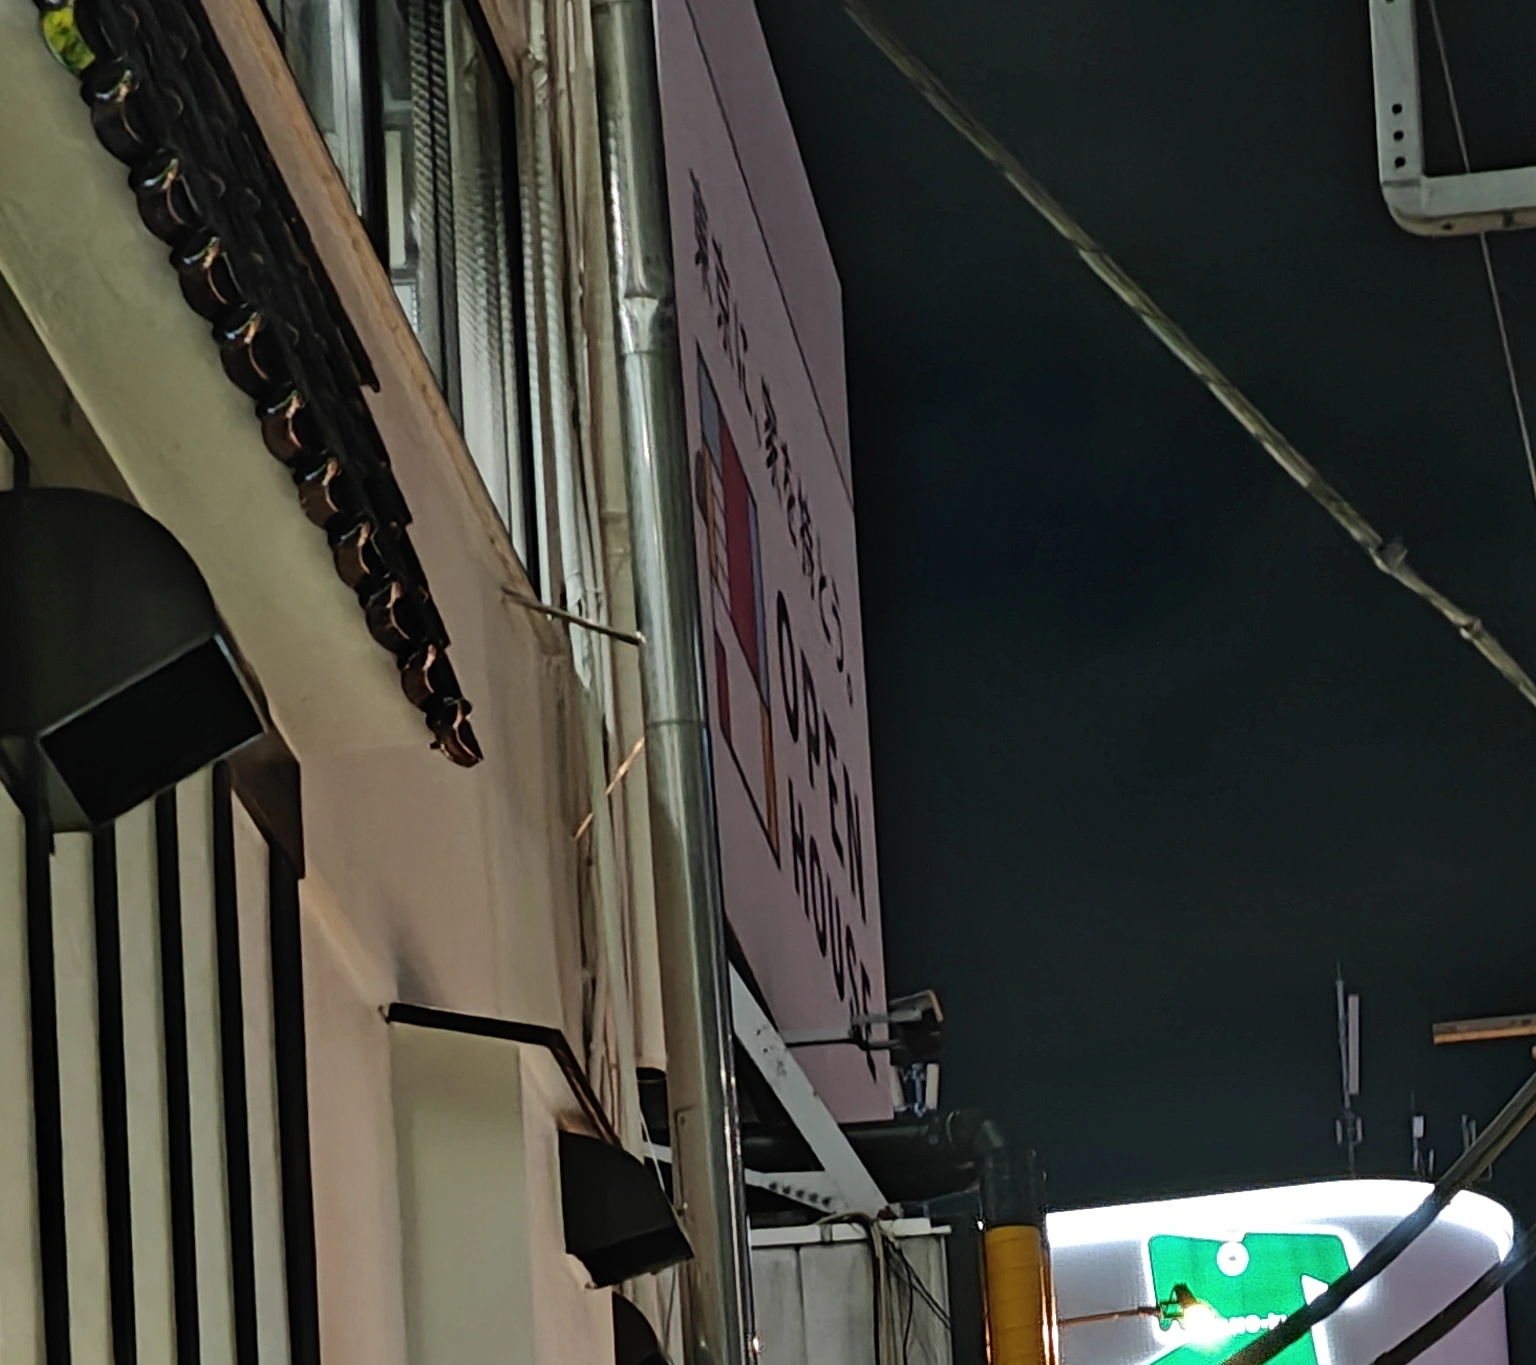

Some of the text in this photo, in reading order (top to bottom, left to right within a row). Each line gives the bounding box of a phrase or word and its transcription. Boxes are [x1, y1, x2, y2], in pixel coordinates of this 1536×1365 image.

[690, 165, 853, 706] 東京に、家を持とう。
[779, 592, 864, 920] OPEN
[788, 778, 876, 1082] HOUSE
